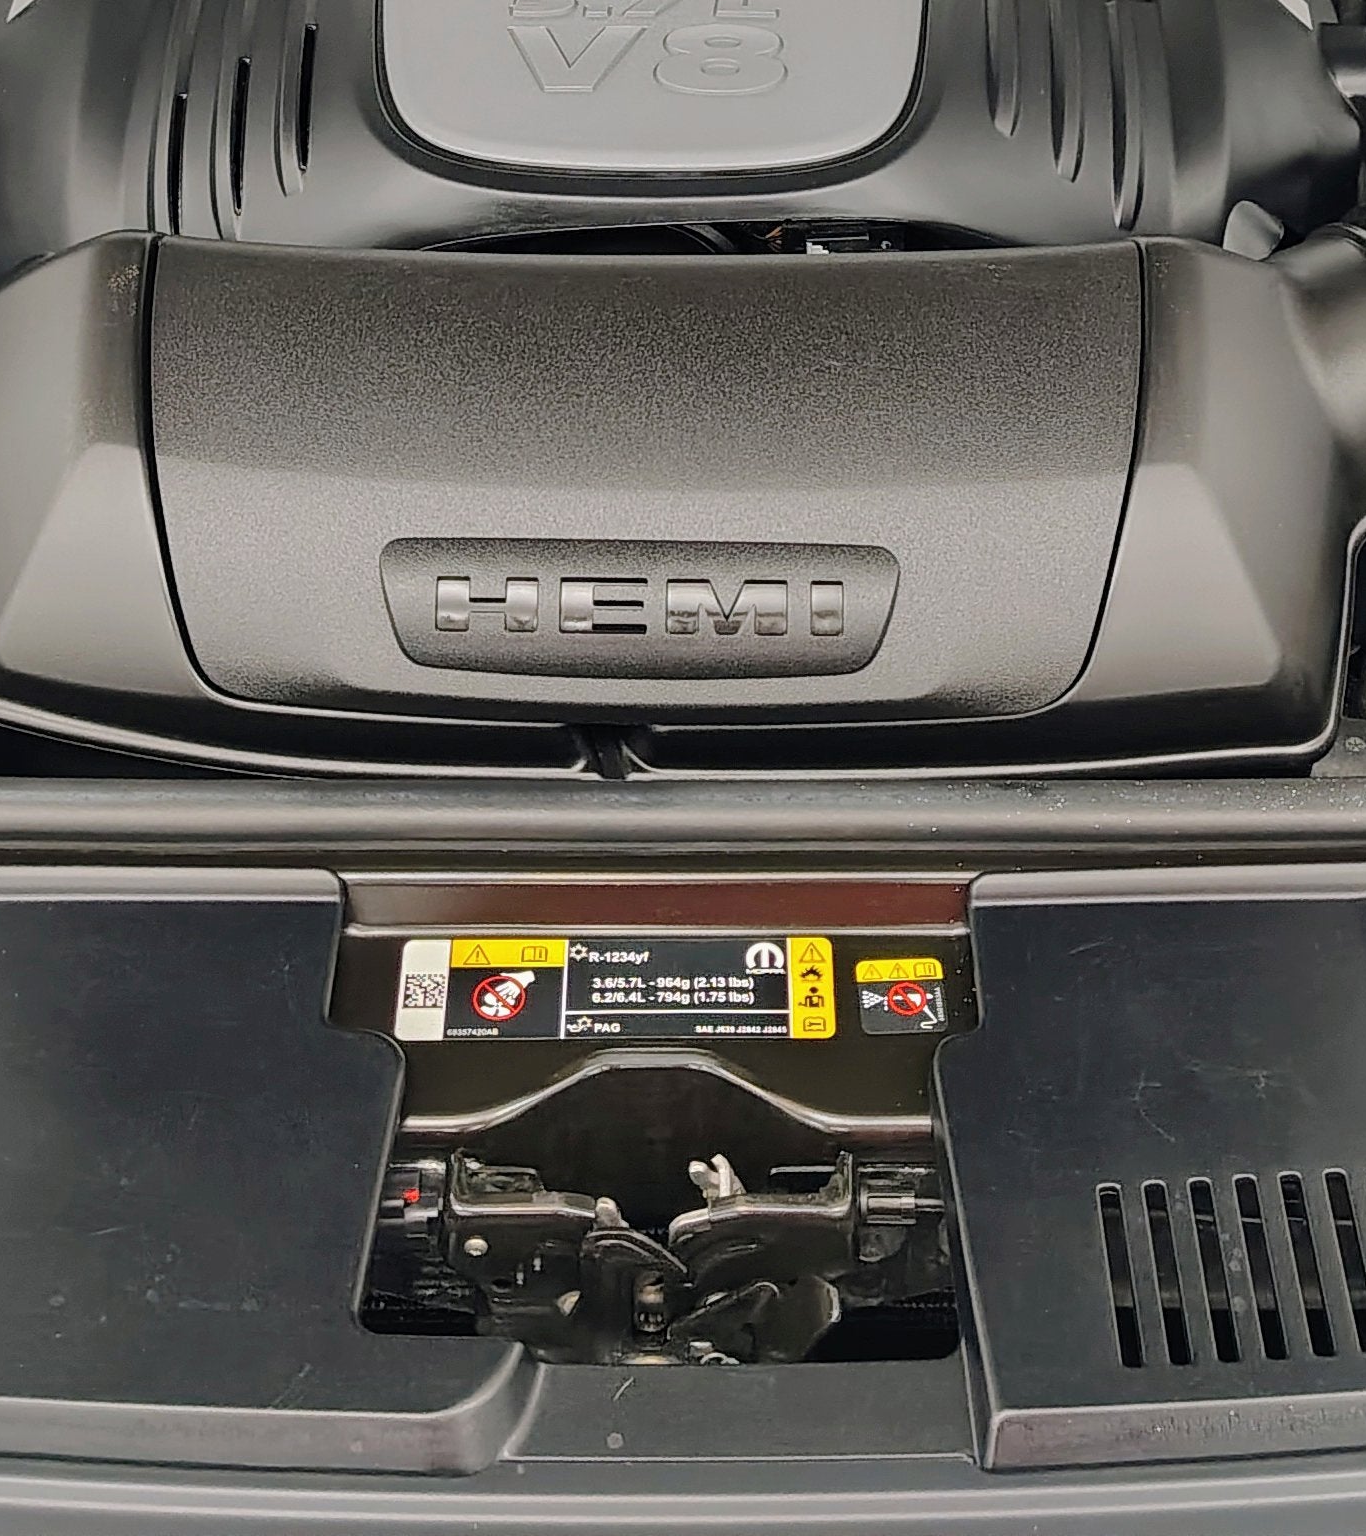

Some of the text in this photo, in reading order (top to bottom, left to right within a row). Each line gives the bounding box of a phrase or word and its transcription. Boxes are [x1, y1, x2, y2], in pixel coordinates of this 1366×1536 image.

[507, 23, 789, 95] V8
[435, 575, 844, 636] HEMI
[588, 951, 650, 965] R-1234yf
[593, 977, 647, 988] 3.6/5.7L
[694, 977, 726, 990] (2.13
[728, 977, 754, 990] lbs)
[591, 992, 647, 1003] 6.2/6.4L
[656, 992, 690, 1005] 794g
[694, 992, 726, 1005] (1.75
[728, 991, 754, 1005] lbs)
[594, 1023, 621, 1033] PAG
[695, 1026, 714, 1034] SAE
